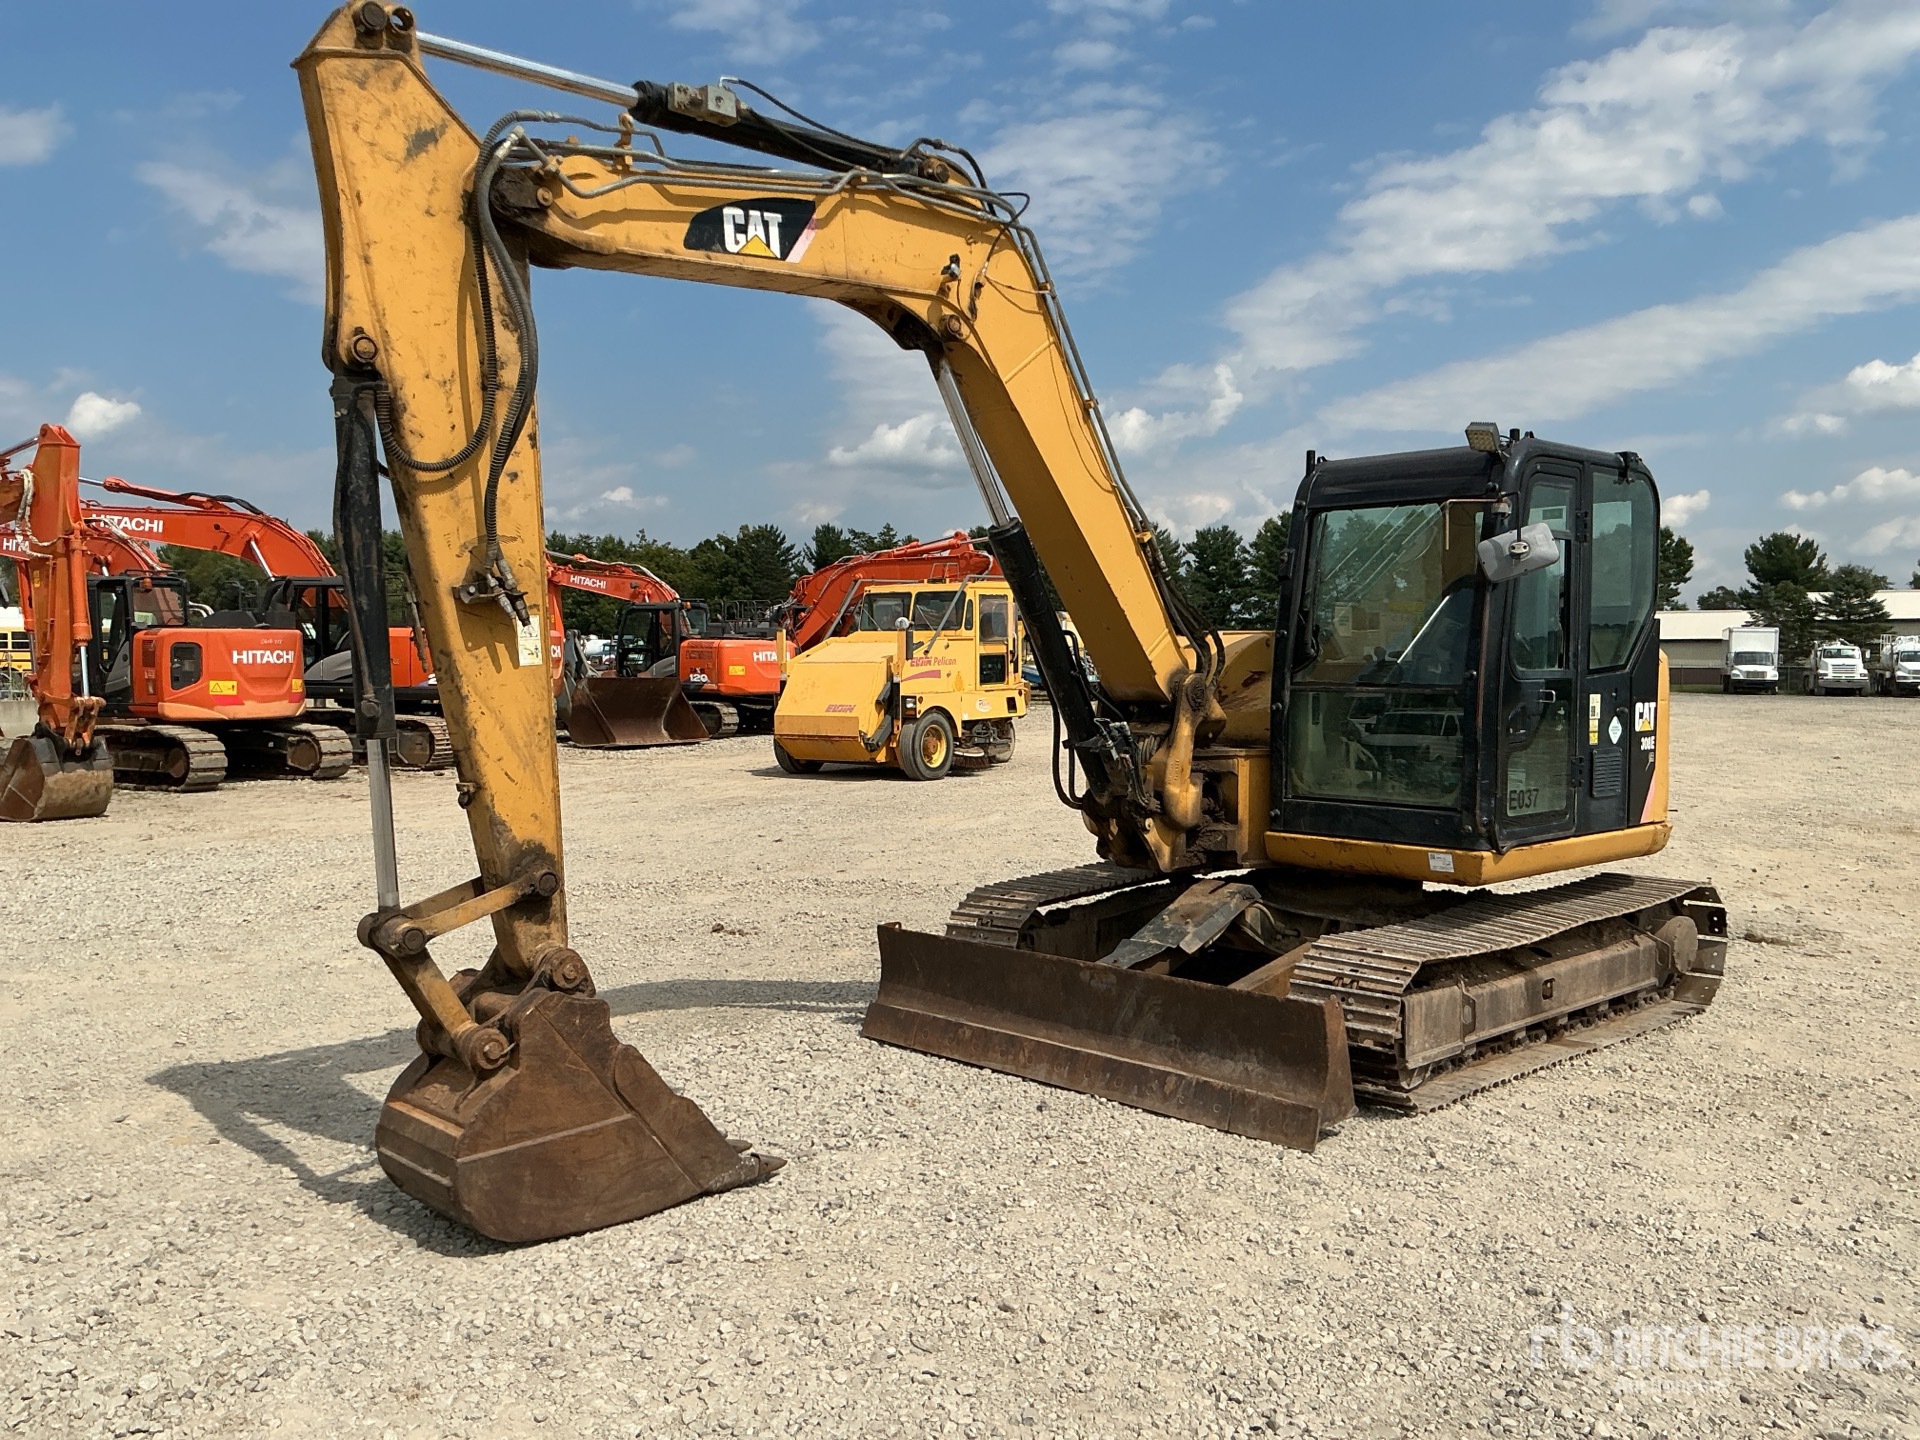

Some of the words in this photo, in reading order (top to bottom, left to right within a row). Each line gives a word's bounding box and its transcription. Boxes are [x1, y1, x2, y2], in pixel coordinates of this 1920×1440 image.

[722, 206, 782, 259] CAT
[570, 575, 607, 589] HITACHI
[232, 650, 295, 664] HITACHI
[752, 650, 791, 663] HITAI
[933, 656, 957, 666] Pelican
[689, 673, 709, 682] 120
[825, 704, 856, 713] ELGIN
[1634, 701, 1657, 732] CAT
[1509, 788, 1540, 810] E037
